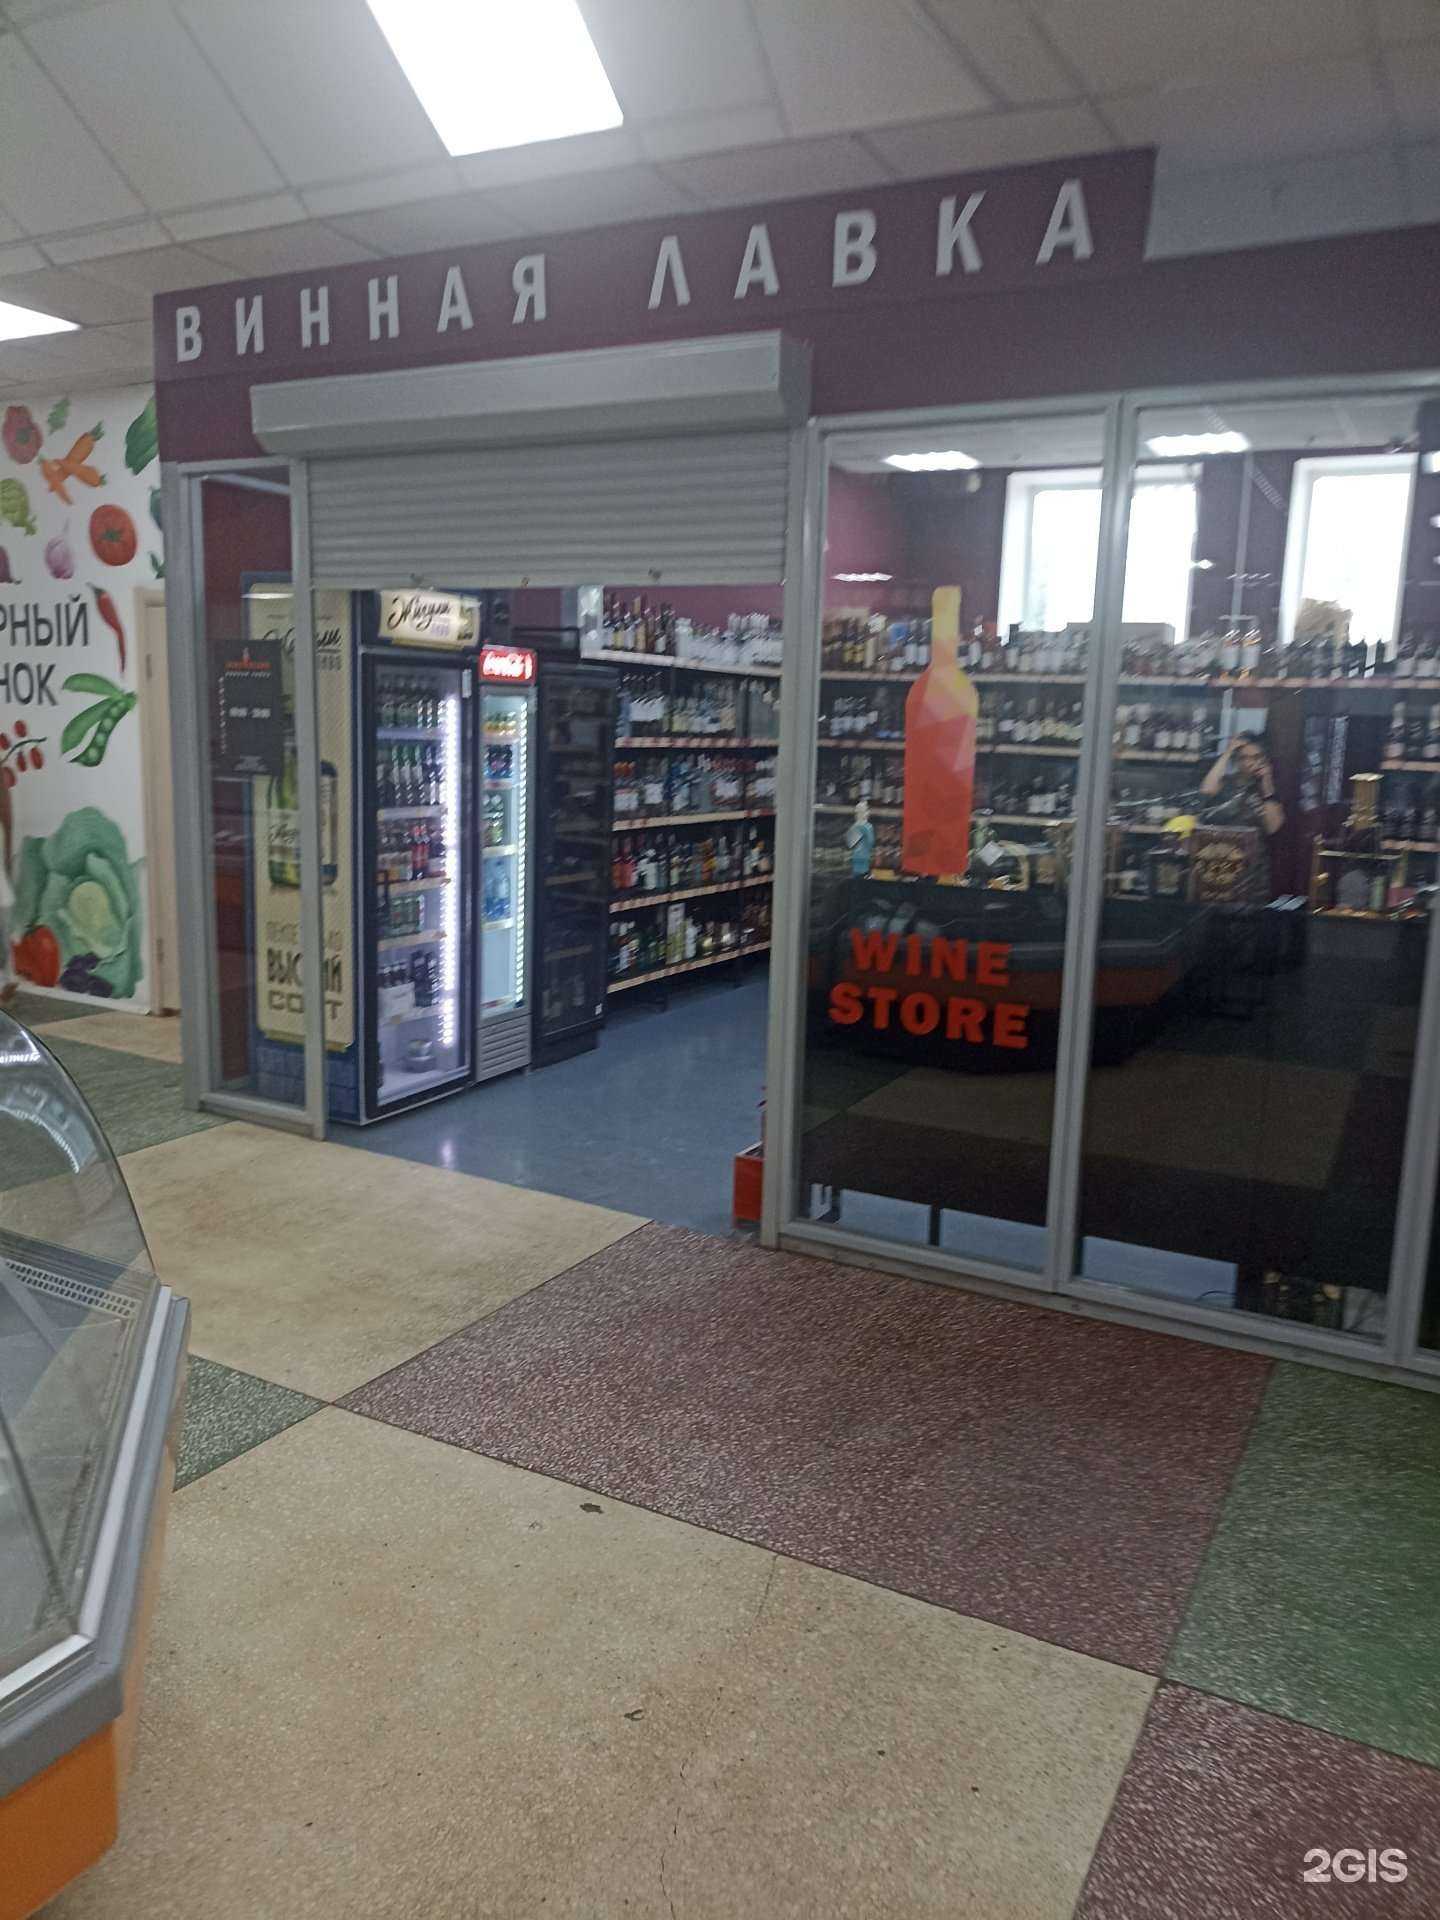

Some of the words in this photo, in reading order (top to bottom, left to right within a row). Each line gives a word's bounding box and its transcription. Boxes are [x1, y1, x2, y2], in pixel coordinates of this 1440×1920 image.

[175, 253, 547, 363] ВИННАЯ
[648, 178, 1095, 310] ЛАВКА
[851, 928, 1012, 986] WINE
[828, 981, 1030, 1050] STORE
